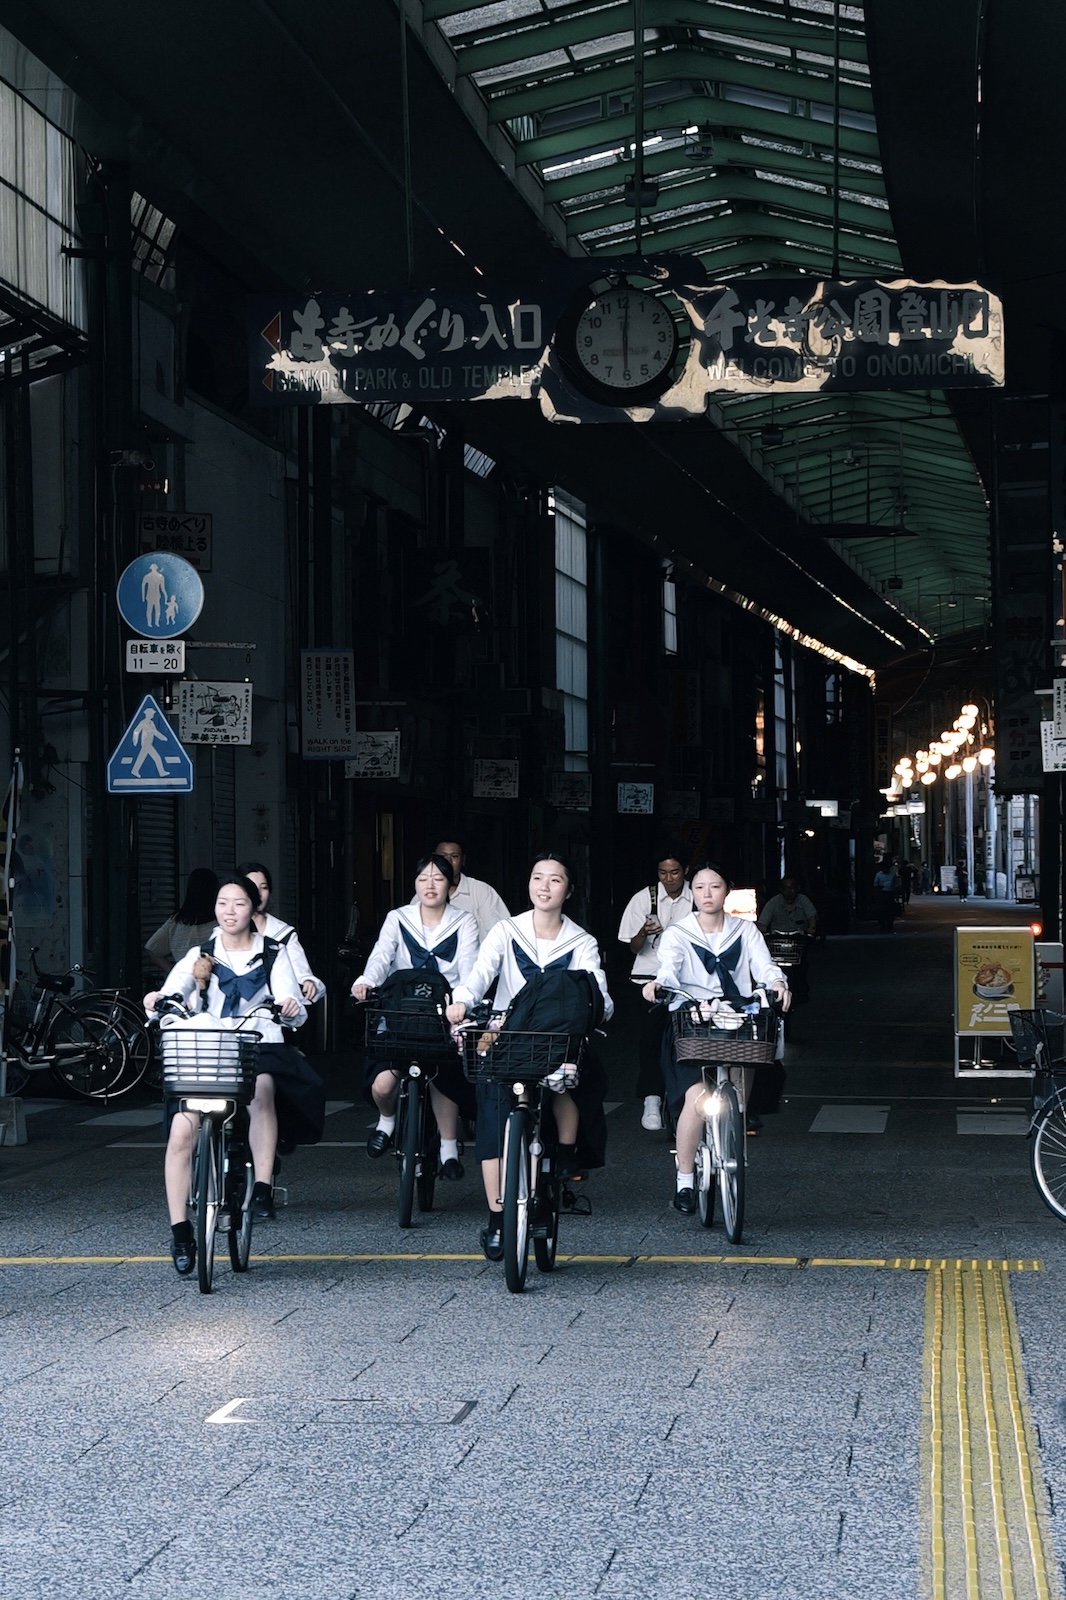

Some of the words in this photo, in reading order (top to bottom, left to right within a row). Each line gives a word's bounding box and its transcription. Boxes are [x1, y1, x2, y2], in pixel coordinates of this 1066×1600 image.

[601, 300, 612, 315] 11
[639, 302, 645, 312] 1
[588, 317, 602, 329] 10
[652, 313, 661, 324] 2
[704, 288, 989, 351] 千光寺公園登山口
[290, 298, 542, 360] 古寺めぐり入口
[584, 336, 593, 347] 9
[657, 332, 666, 343] 3
[590, 355, 599, 365] 8
[653, 351, 662, 361] 4
[604, 366, 613, 377] 7
[640, 364, 649, 376] 5
[706, 355, 821, 380] WELCOME
[828, 354, 857, 377] TO
[356, 367, 398, 390] PARK
[402, 372, 412, 389] &
[418, 366, 452, 389] OLD
[462, 364, 543, 388] TEMPLES
[623, 370, 632, 381] 6
[142, 514, 207, 533] 古寺めぐり
[130, 643, 182, 655] 自転車を除く
[164, 658, 178, 669] 20
